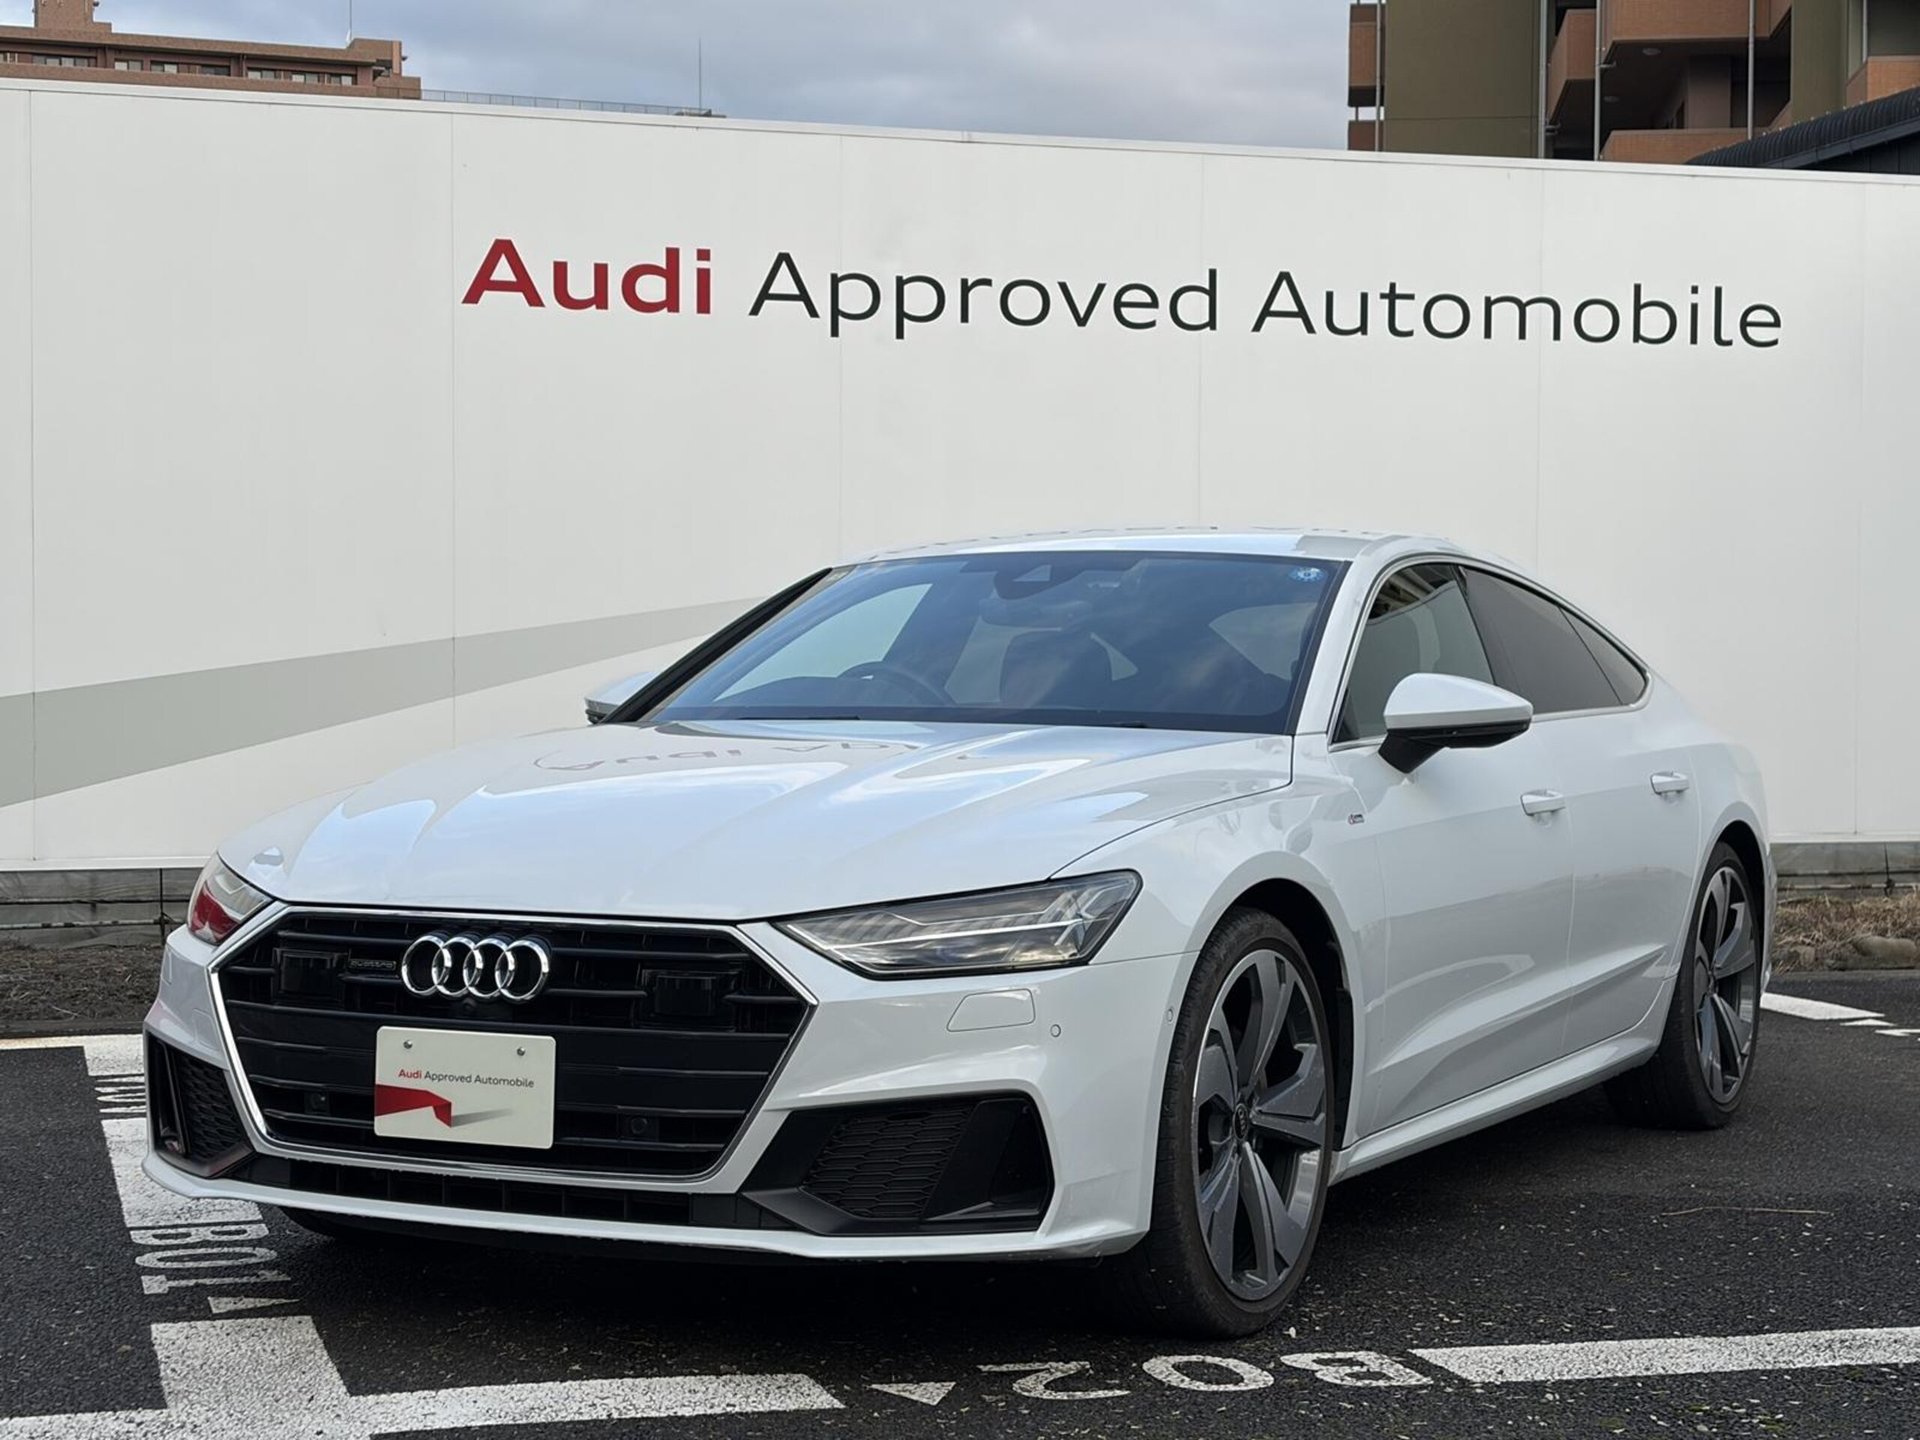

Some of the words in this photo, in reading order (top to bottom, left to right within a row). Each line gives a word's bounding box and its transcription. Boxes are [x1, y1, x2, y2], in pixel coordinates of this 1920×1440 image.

[461, 239, 711, 315] Audi
[748, 252, 1217, 340] Approved
[1251, 271, 1782, 349] Automobile
[397, 1068, 422, 1079] Audi
[424, 1070, 472, 1084] Approved
[474, 1075, 535, 1088] Automobile
[976, 1351, 1435, 1399] B02
